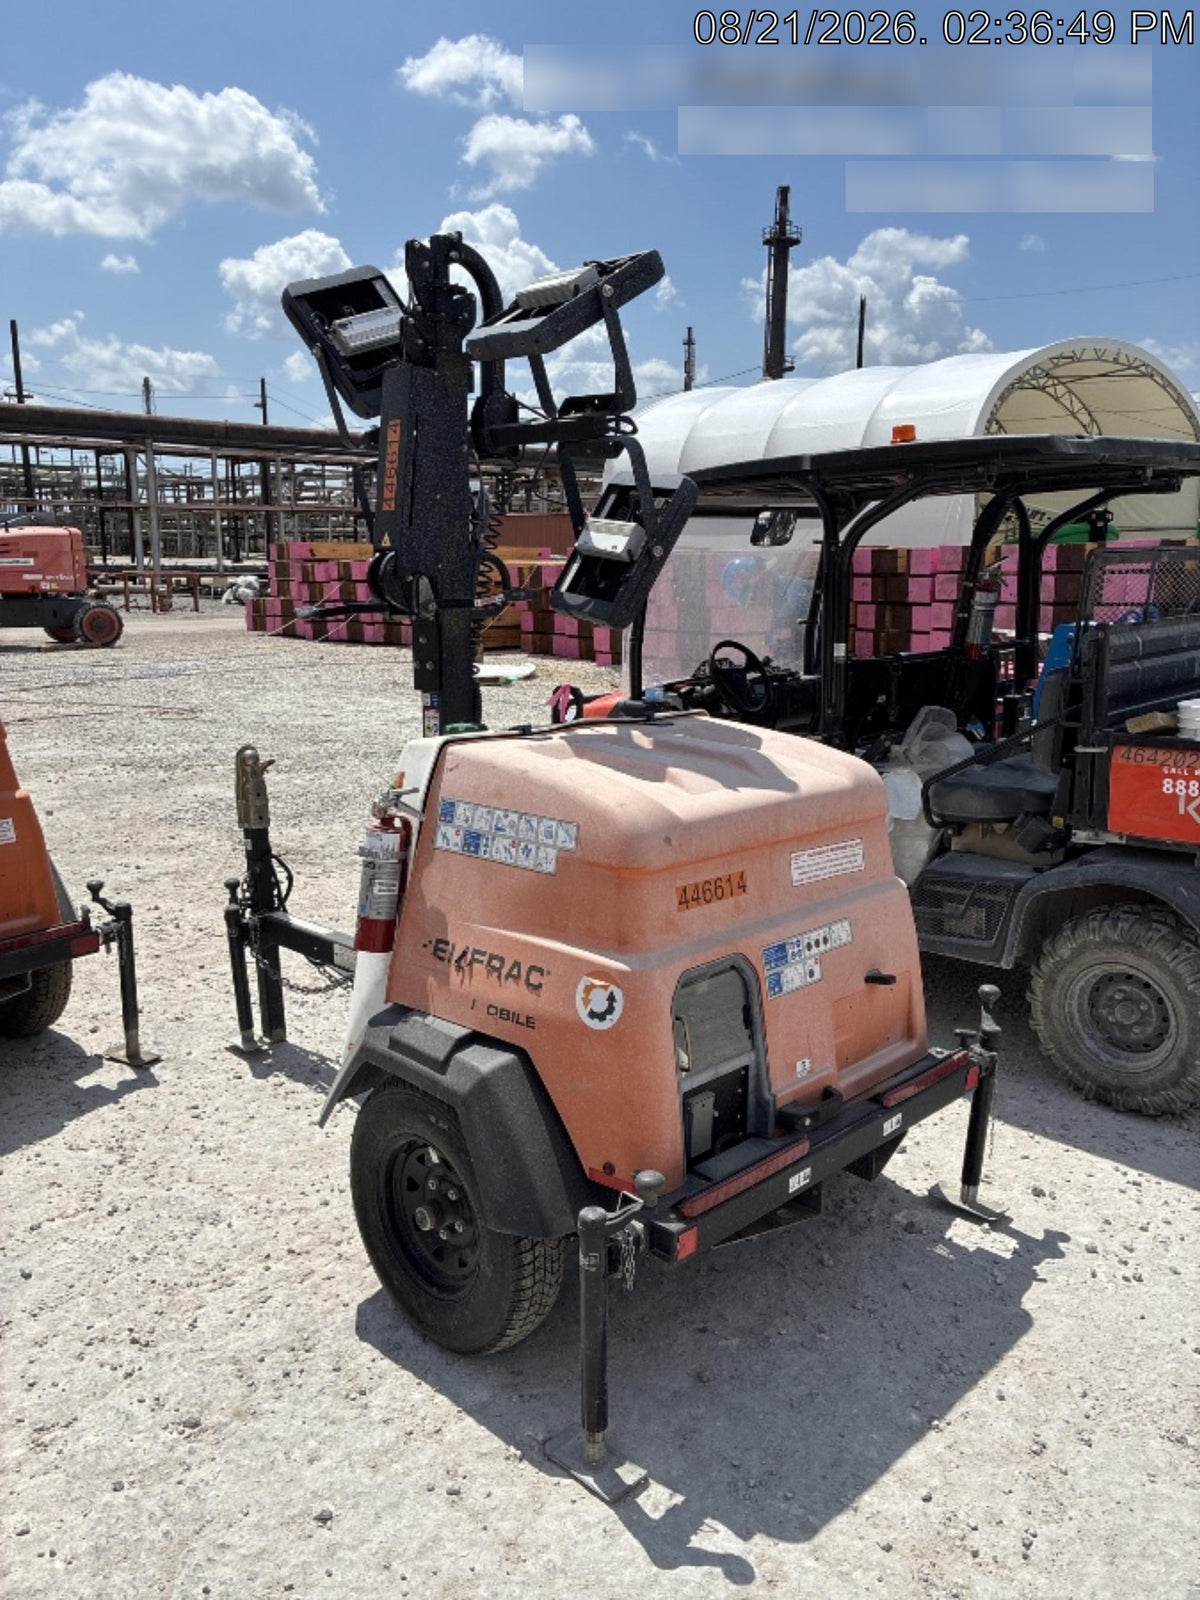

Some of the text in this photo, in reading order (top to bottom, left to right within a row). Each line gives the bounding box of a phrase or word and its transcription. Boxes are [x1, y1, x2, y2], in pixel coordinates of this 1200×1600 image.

[383, 422, 400, 510] 446614
[678, 870, 747, 910] 446614
[470, 998, 536, 1030] OBILE
